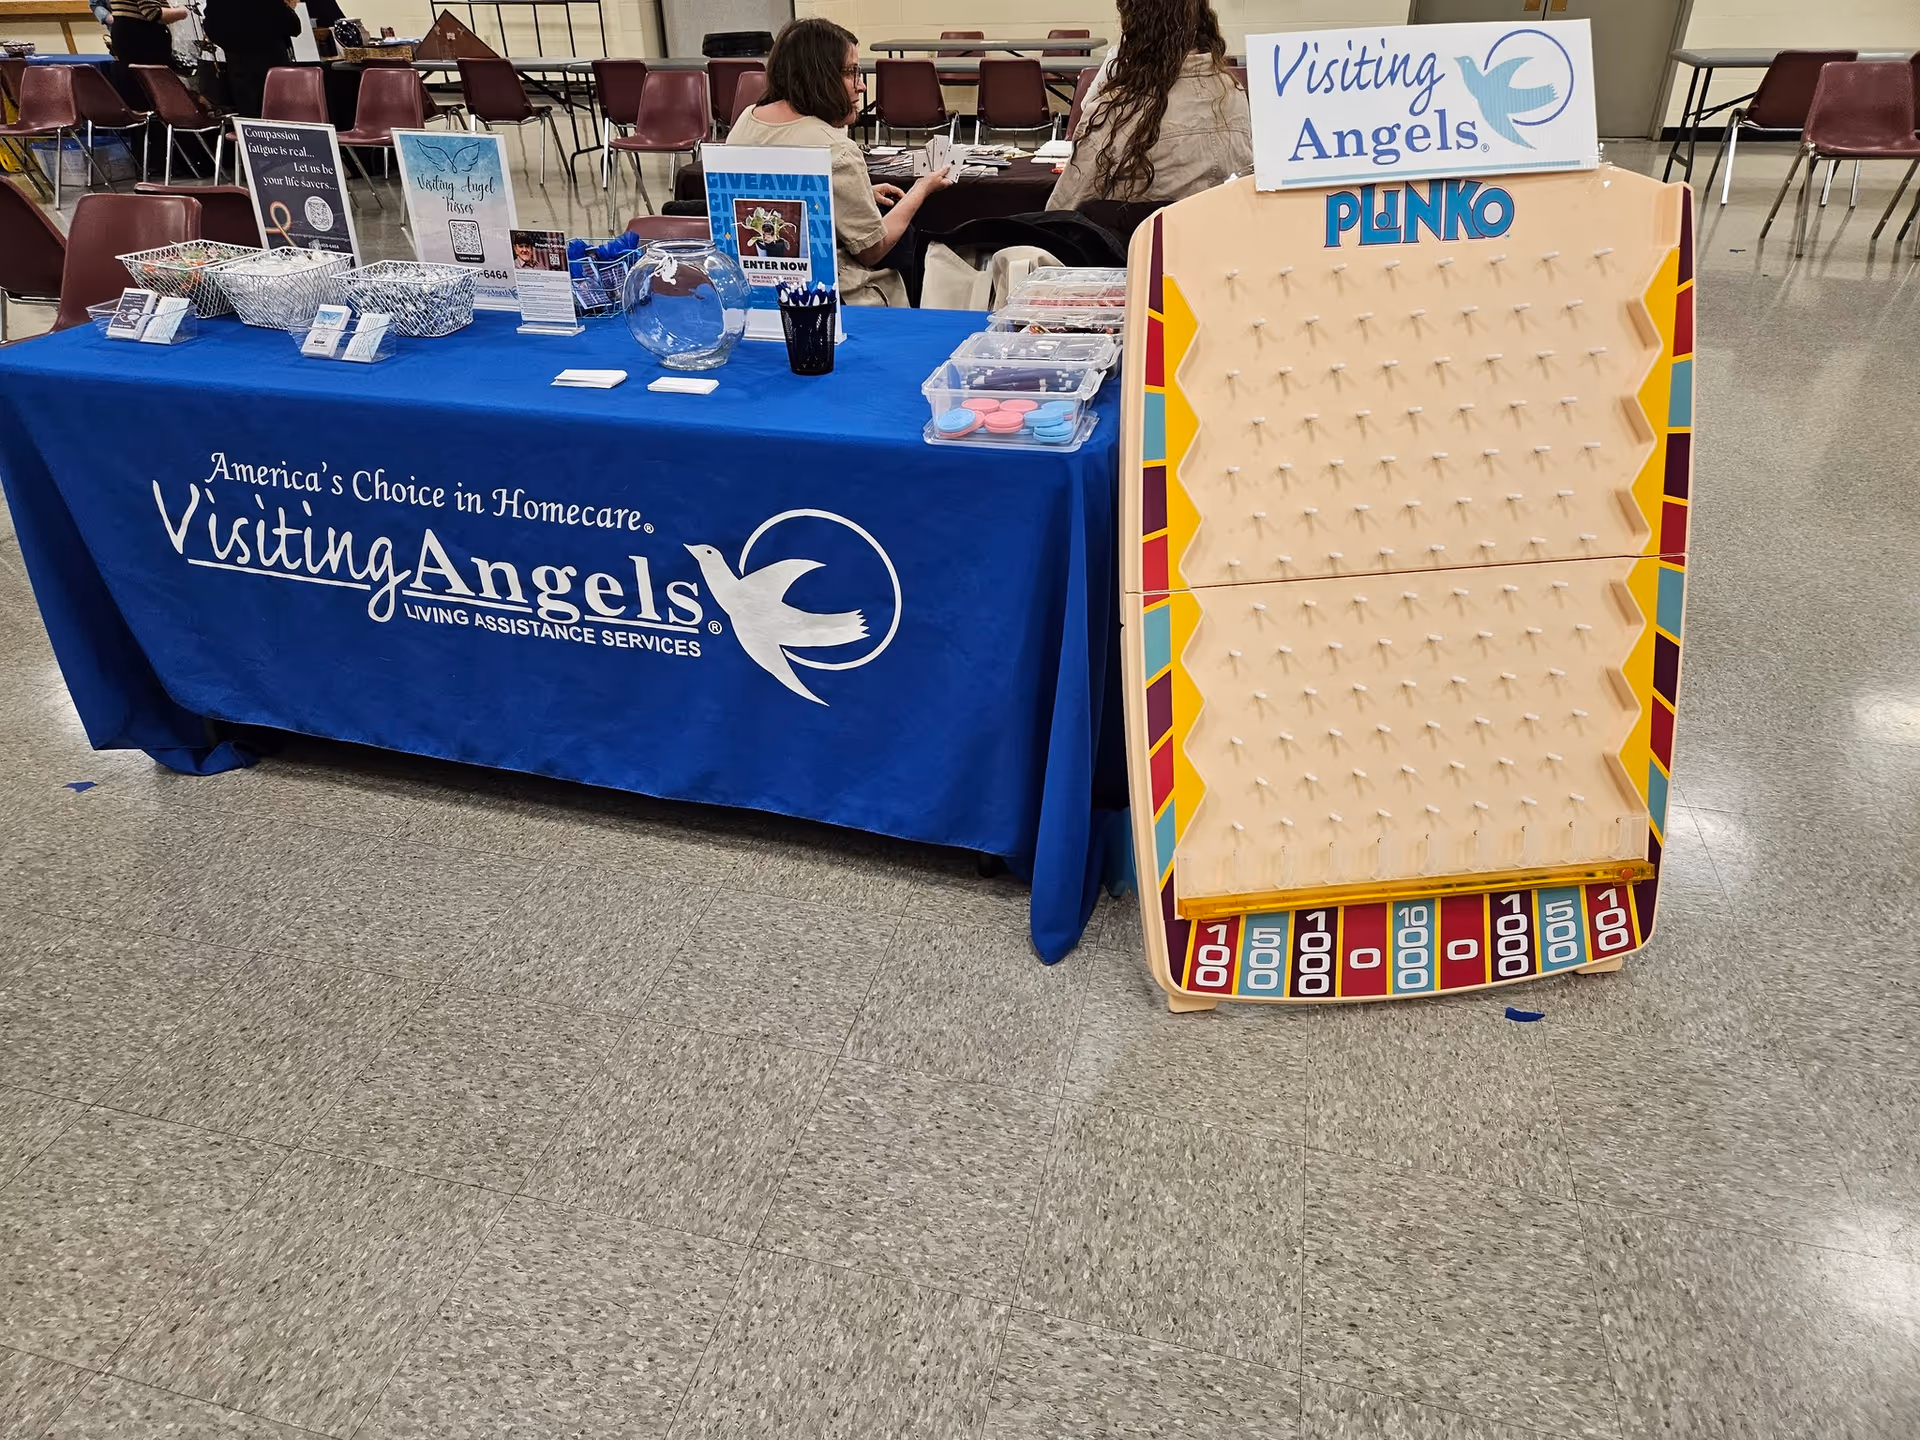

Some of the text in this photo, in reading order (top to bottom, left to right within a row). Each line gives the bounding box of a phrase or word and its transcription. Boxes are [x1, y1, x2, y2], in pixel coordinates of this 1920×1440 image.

[1273, 38, 1445, 116] Visiting
[244, 127, 300, 142] Compassion
[248, 142, 315, 158] fatigue is real...
[293, 162, 334, 175] Let us be
[262, 175, 338, 191] your life savers...
[417, 173, 495, 201] Visiting Angel
[706, 172, 829, 191] GIVEAWAY
[1323, 178, 1515, 248] PLINKO
[743, 260, 808, 271] ENTER NOW
[204, 452, 344, 495] America's
[352, 468, 445, 508] Choice
[454, 482, 485, 514] in
[152, 480, 412, 622] Visiting
[404, 603, 702, 658] LIVING ASSISTANCE SERVICES
[1350, 948, 1381, 969] 0
[1446, 938, 1478, 961] 0
